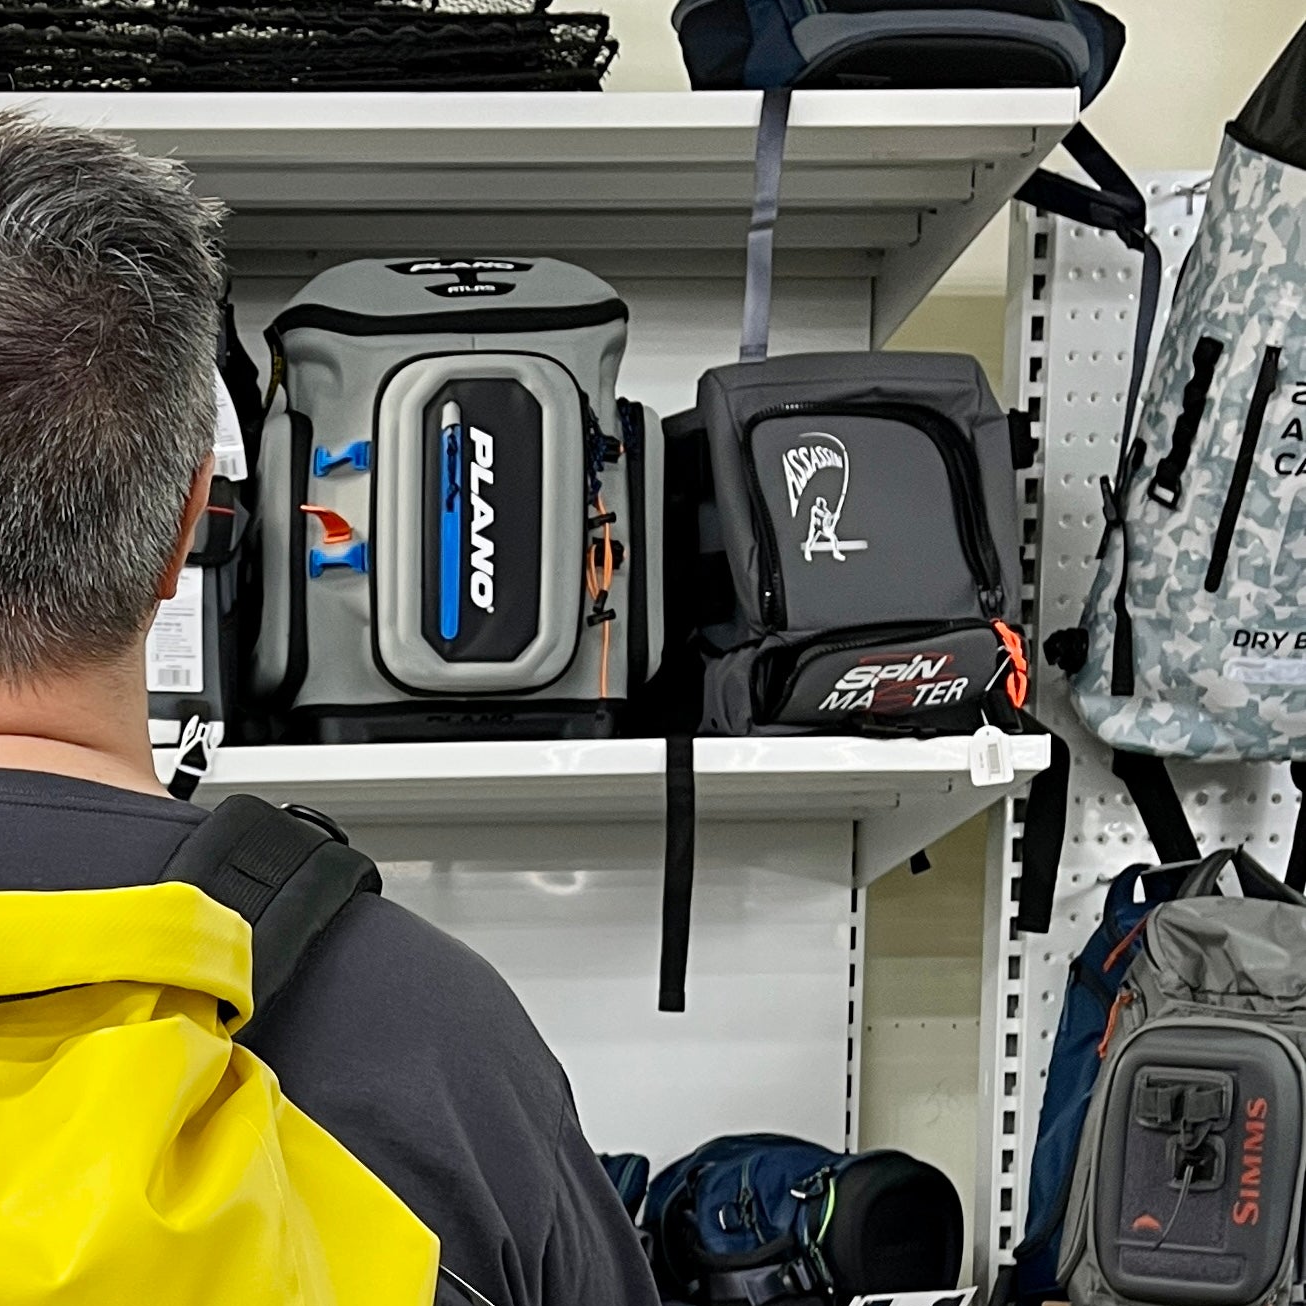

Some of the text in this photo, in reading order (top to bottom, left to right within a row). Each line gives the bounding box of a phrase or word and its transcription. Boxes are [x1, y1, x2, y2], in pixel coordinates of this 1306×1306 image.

[409, 261, 515, 273] PLANO
[447, 284, 496, 293] ATLAS
[782, 446, 843, 518] ASSASSIN
[469, 427, 495, 613] PLANO
[1233, 629, 1289, 650] DRY
[835, 654, 948, 690] SPIN
[1233, 1098, 1268, 1225] SIMMS
